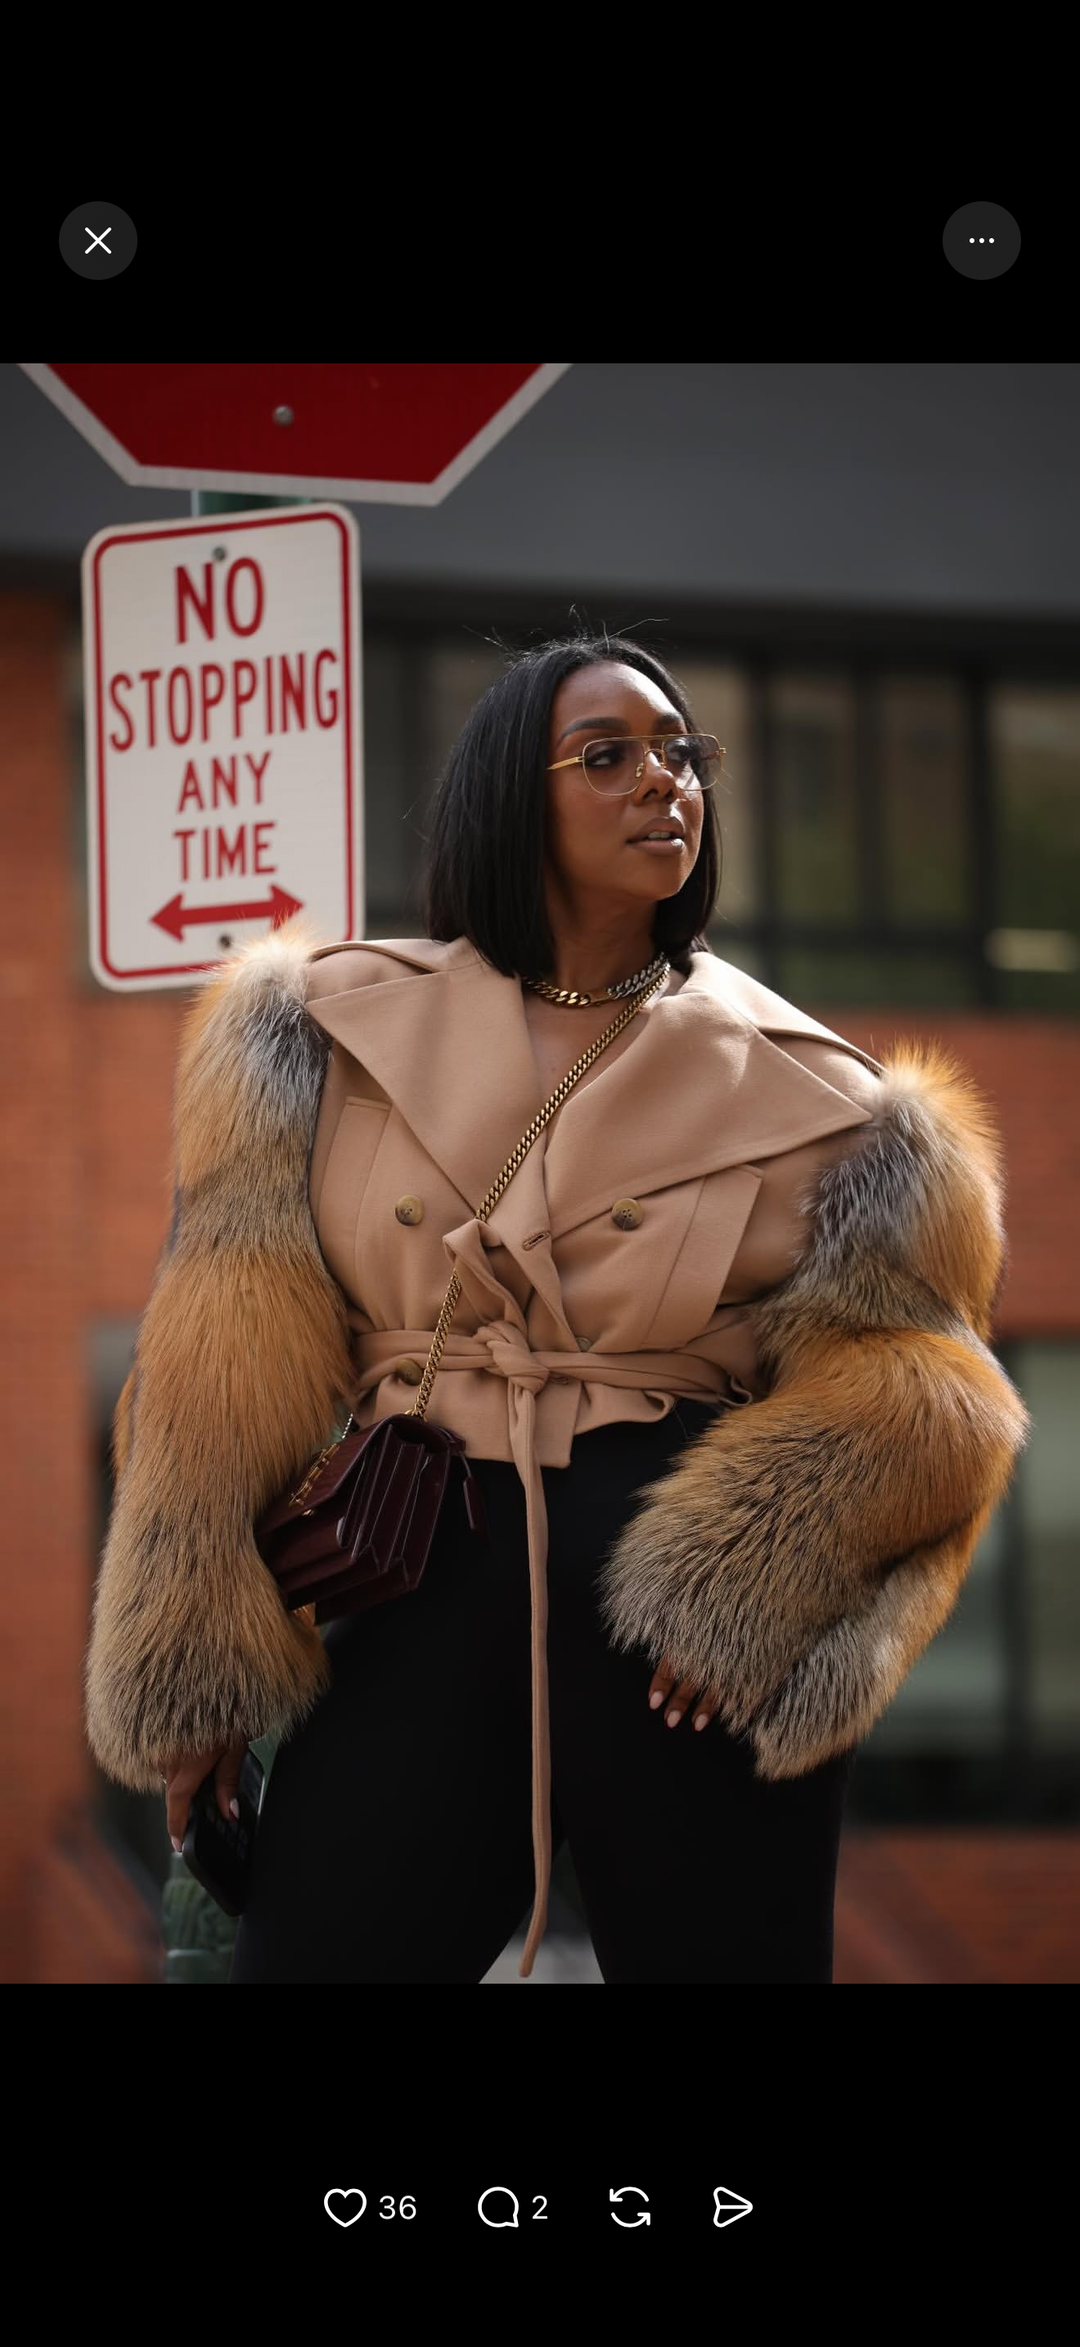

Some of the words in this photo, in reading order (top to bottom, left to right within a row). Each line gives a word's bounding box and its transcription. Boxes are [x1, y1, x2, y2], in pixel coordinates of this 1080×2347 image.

[175, 557, 264, 644] NO
[109, 648, 339, 752] STOPPING
[177, 752, 272, 813] ANY
[174, 822, 277, 882] TIME
